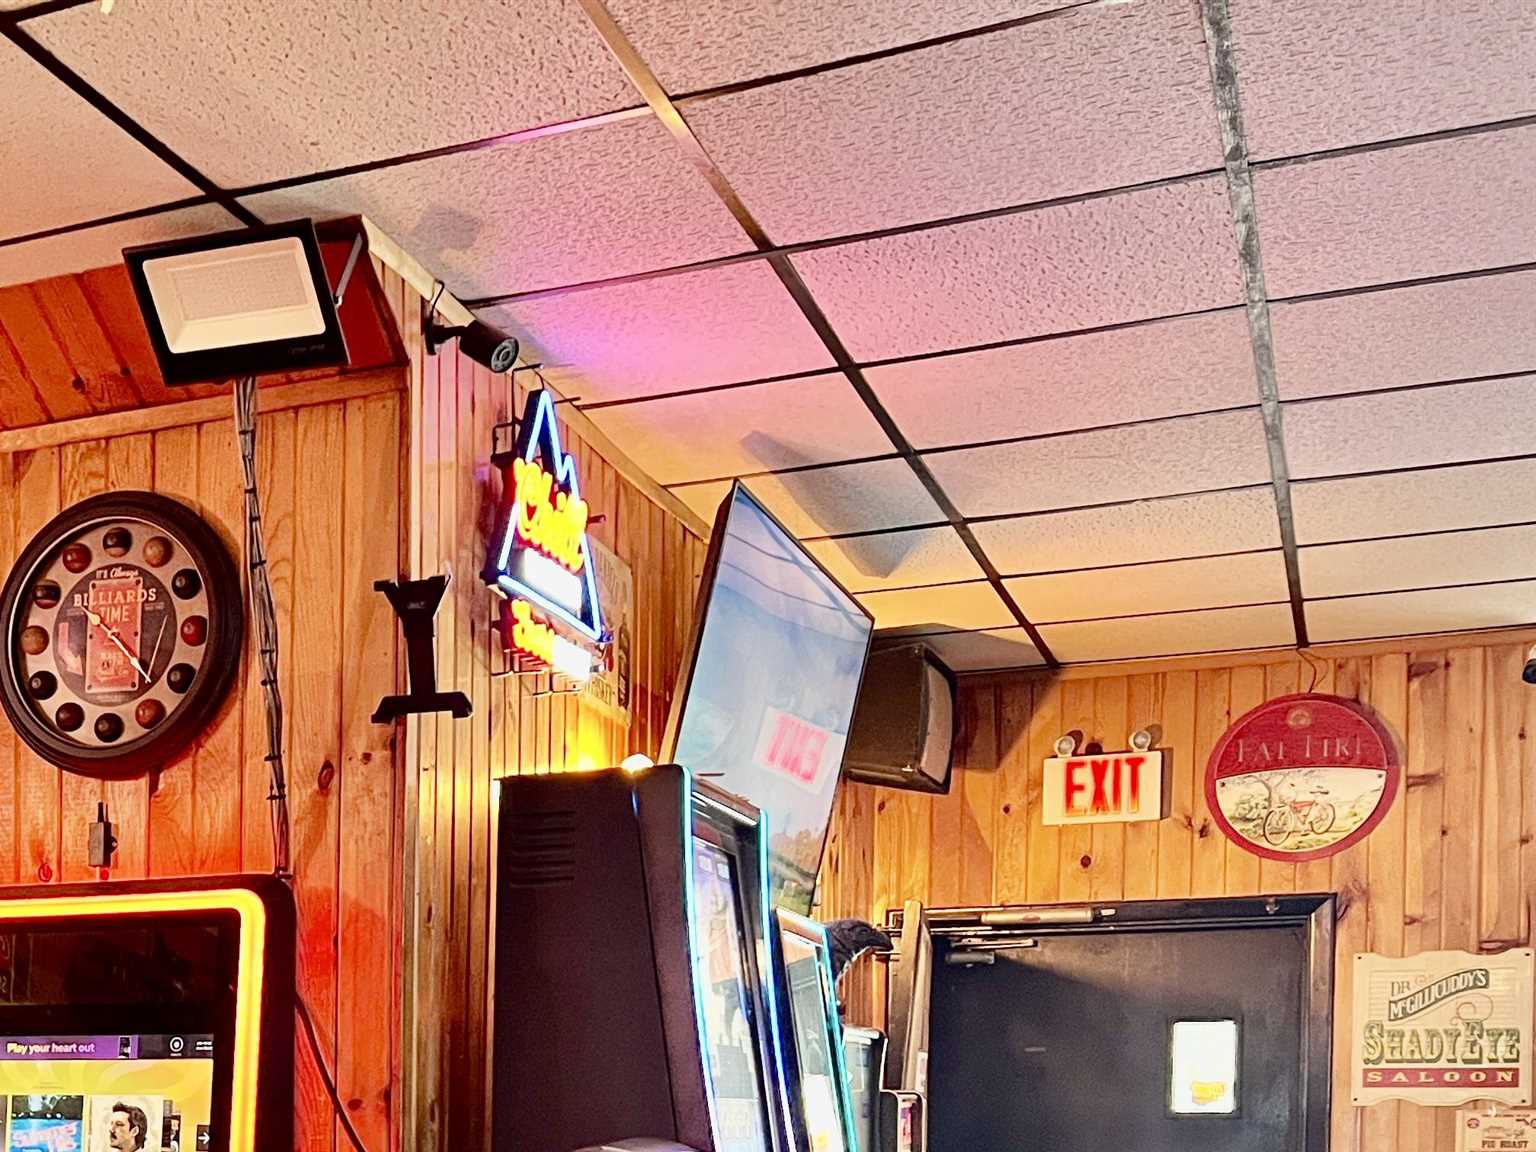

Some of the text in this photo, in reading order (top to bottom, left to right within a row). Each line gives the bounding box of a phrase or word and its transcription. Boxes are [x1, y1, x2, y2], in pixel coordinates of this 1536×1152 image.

[73, 588, 156, 608] BILLIARDS
[1065, 756, 1146, 816] EXIT
[1391, 981, 1410, 997] DR
[7, 1043, 95, 1055] Play your heart out
[1367, 1071, 1514, 1083] SALOON
